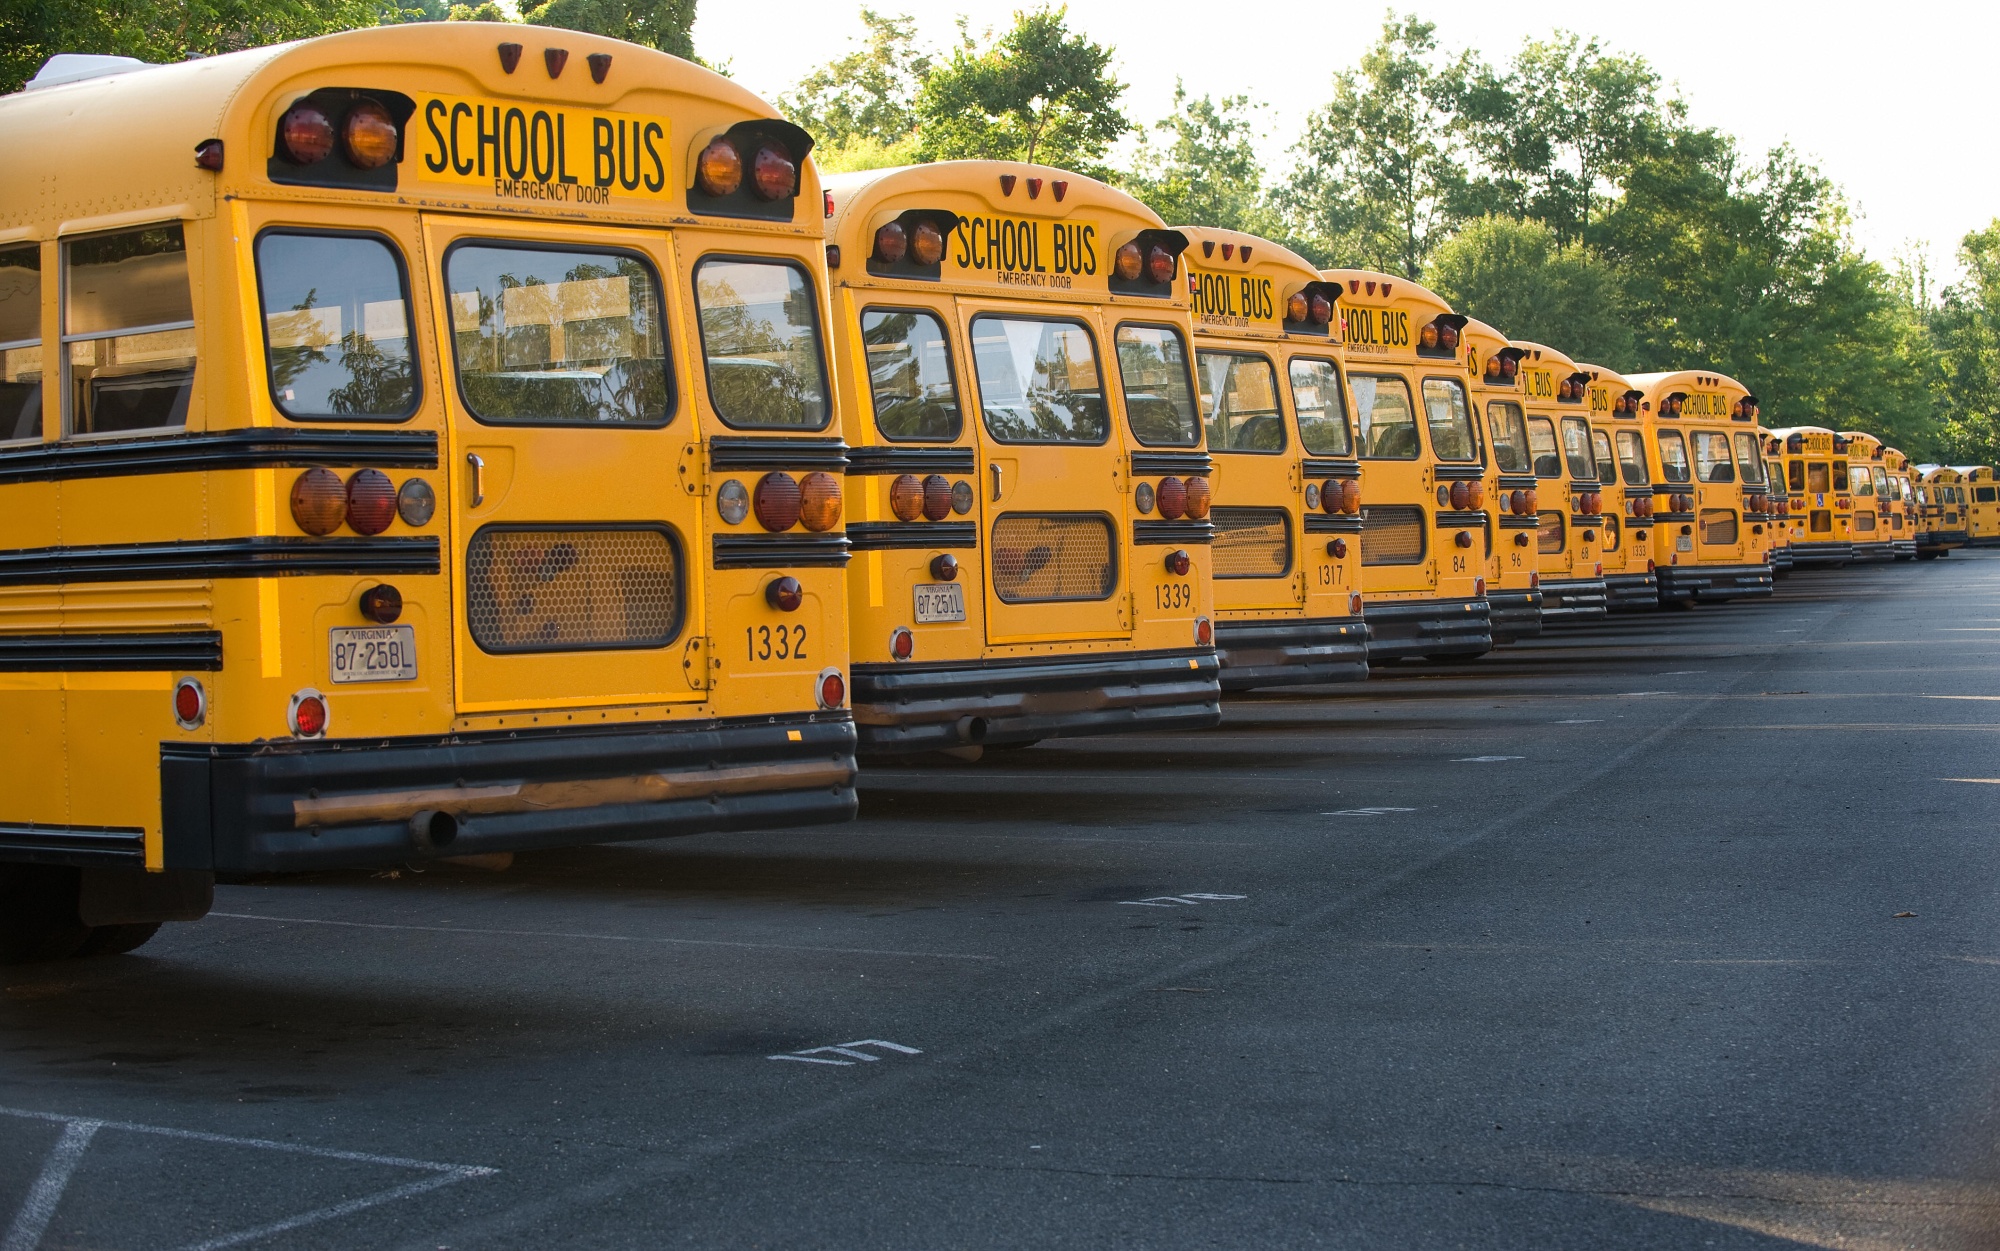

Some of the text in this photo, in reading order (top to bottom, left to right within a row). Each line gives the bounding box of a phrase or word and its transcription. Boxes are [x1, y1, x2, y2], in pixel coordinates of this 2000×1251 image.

[425, 98, 665, 193] SCHOOL BUS
[495, 178, 610, 205] EMERGENCY DOOR
[956, 215, 1097, 275] SCHOOL BUS
[997, 271, 1072, 289] EMERGENCY DOOR
[1189, 273, 1273, 319] HOOL BUS
[1200, 314, 1250, 328] EMERGENCY DOOR
[1340, 308, 1409, 346] HOOL BUS
[1534, 371, 1552, 397] BUS
[1591, 388, 1608, 411] BUS
[1683, 394, 1727, 416] SCHOOL BUS
[1511, 552, 1522, 567] 96
[1581, 546, 1589, 560] 68
[1632, 545, 1647, 557] 1333
[1318, 564, 1343, 586] 1317
[1453, 555, 1466, 573] 84
[1155, 583, 1191, 609] 1339
[351, 630, 393, 640] VIRGINIA
[746, 624, 807, 662] 1332
[335, 641, 413, 671] 87-258L
